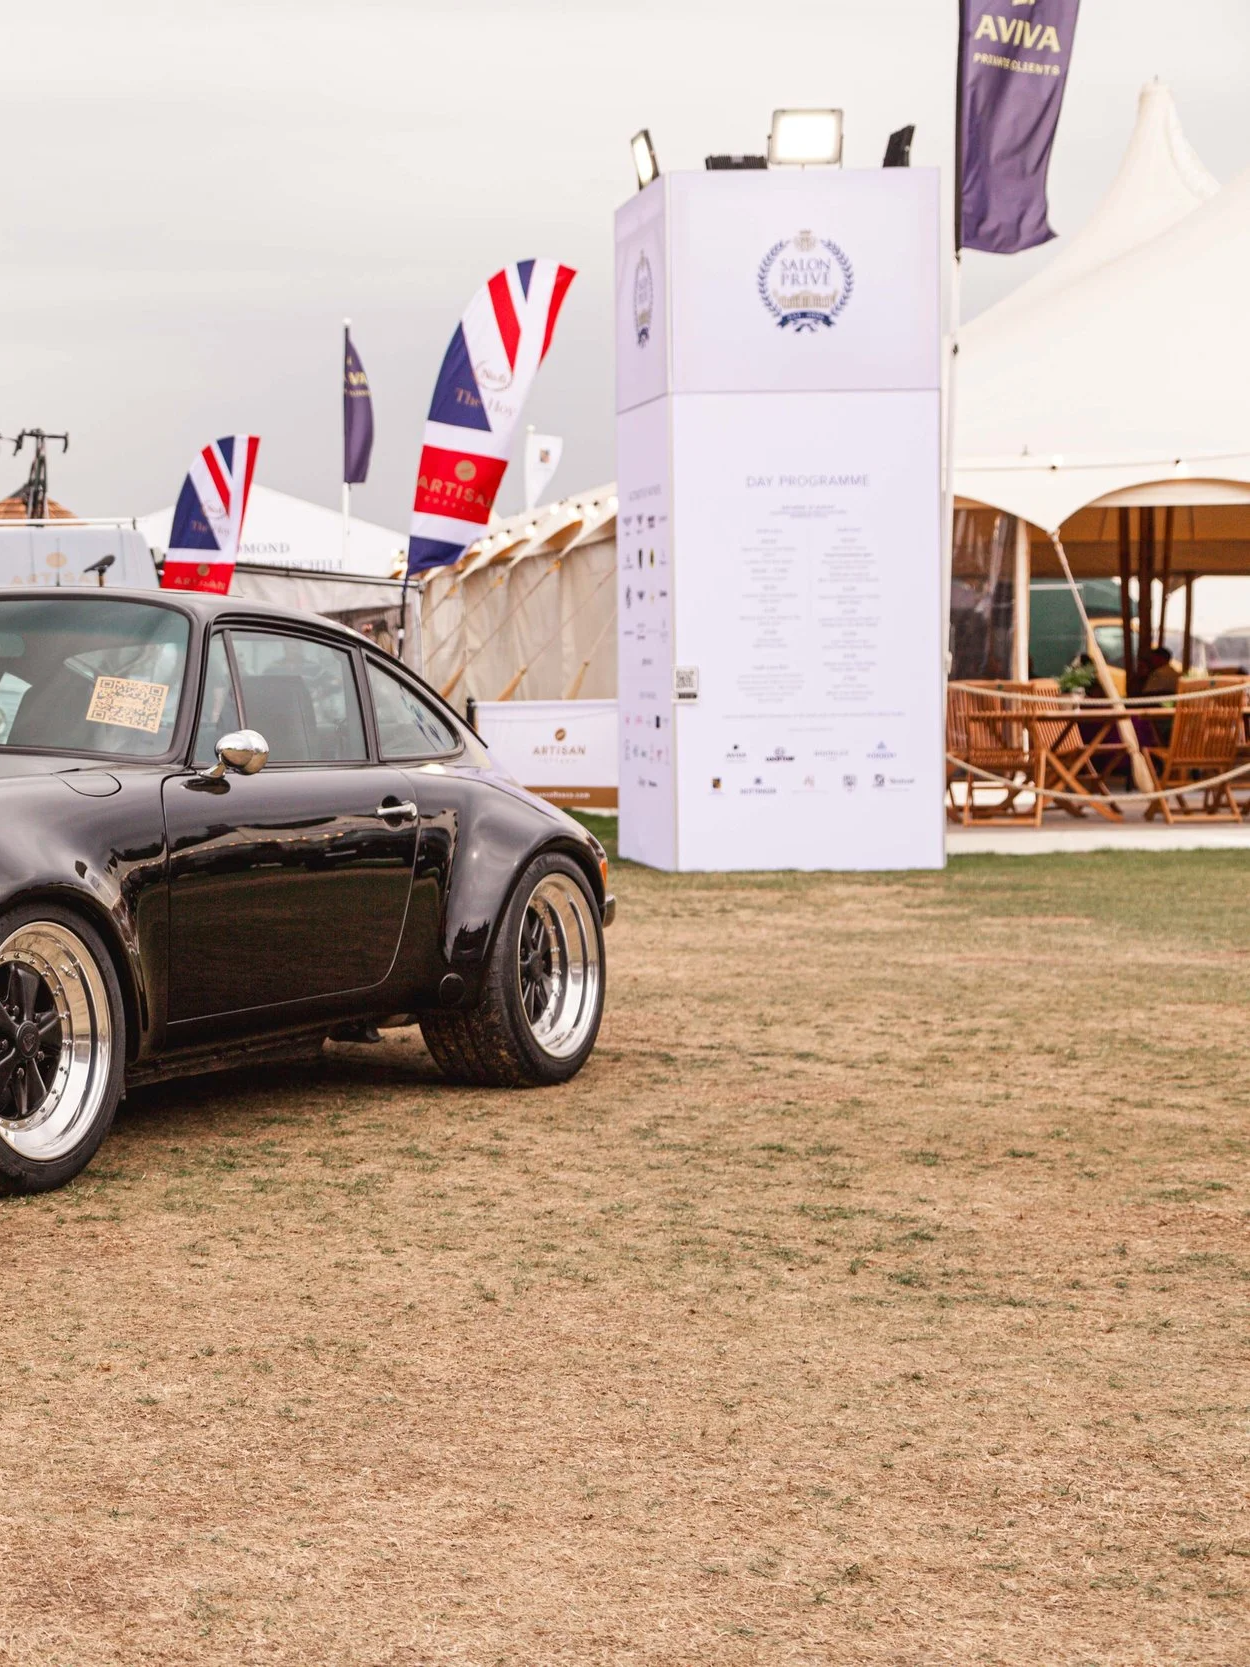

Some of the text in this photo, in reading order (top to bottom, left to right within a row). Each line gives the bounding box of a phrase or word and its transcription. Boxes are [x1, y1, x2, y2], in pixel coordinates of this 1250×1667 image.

[974, 14, 1061, 53] AVIVA
[781, 257, 831, 271] SALON
[746, 473, 871, 488] DAY PROGRAMME
[533, 744, 587, 756] ARTISAN
